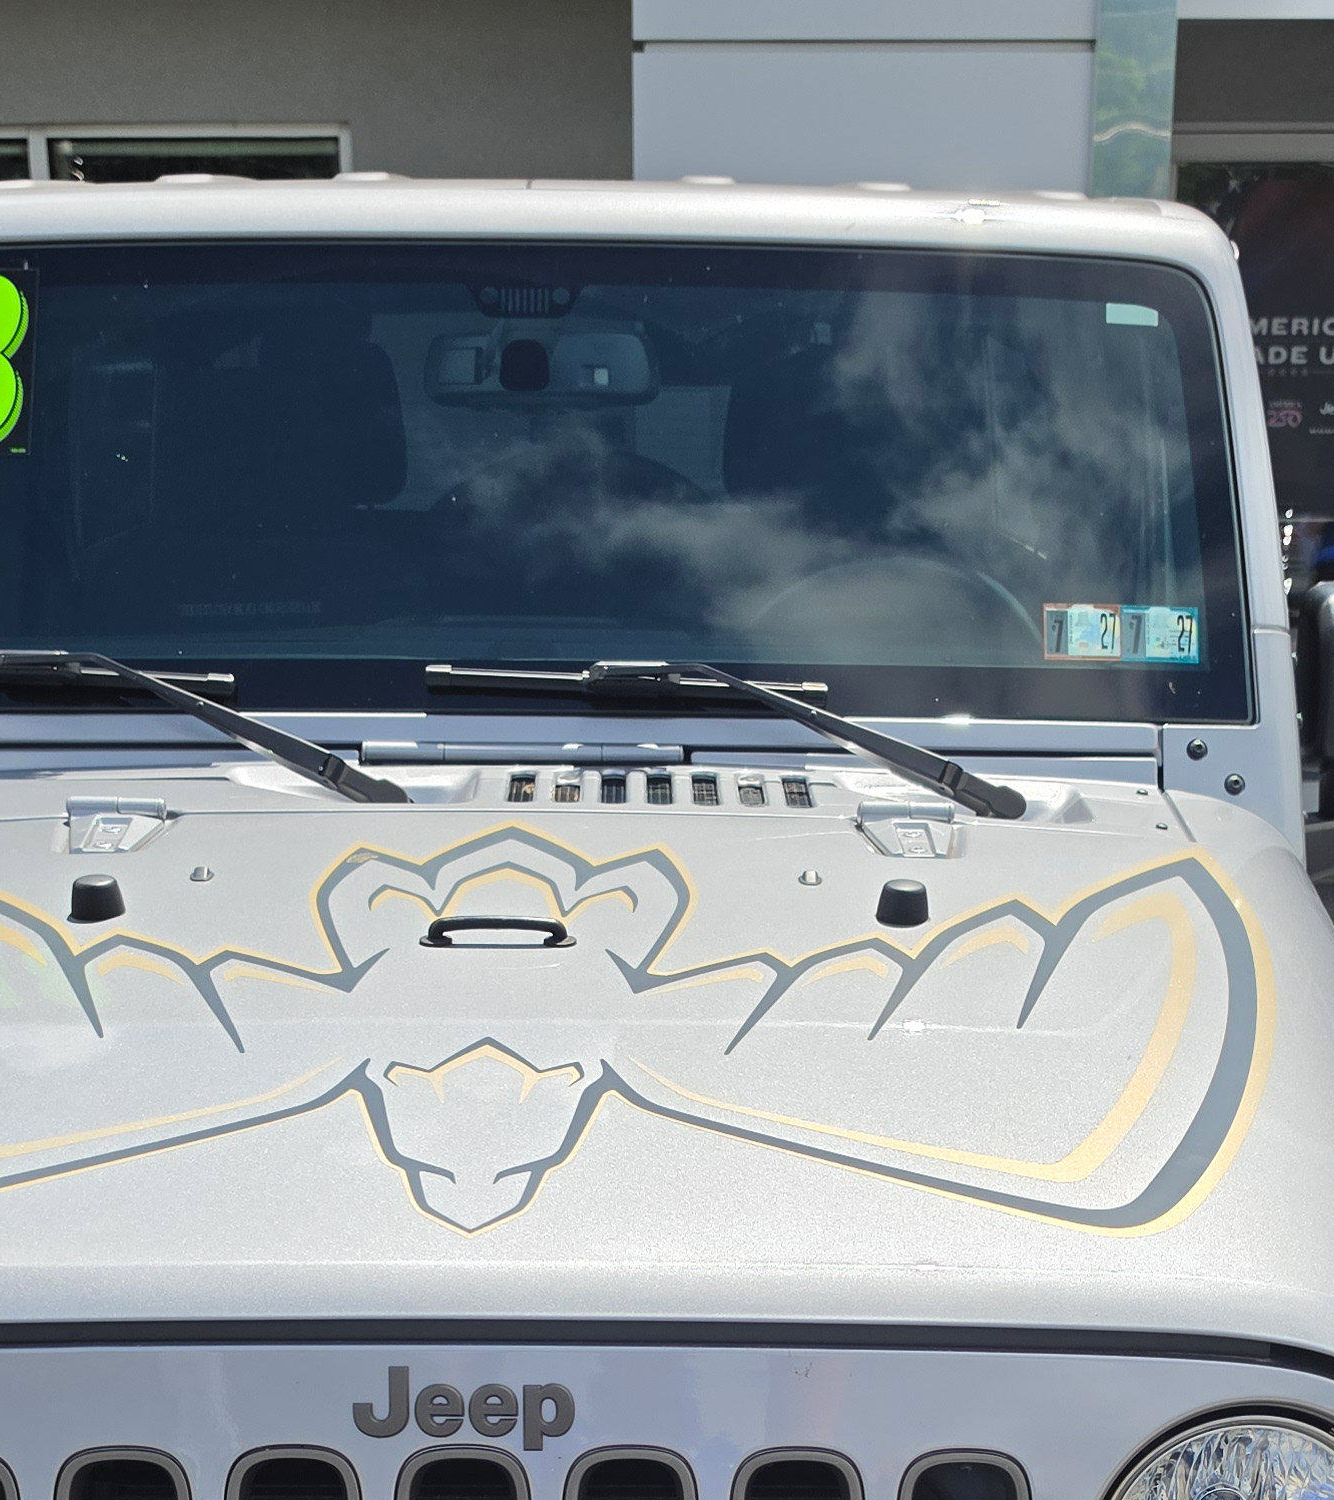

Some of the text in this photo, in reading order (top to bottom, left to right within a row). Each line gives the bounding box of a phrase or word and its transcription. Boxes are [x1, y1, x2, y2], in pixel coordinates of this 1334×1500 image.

[1255, 345, 1309, 365] ADE
[1100, 613, 1116, 650] 27
[1177, 614, 1194, 654] 27
[353, 1365, 575, 1451] Jeep
